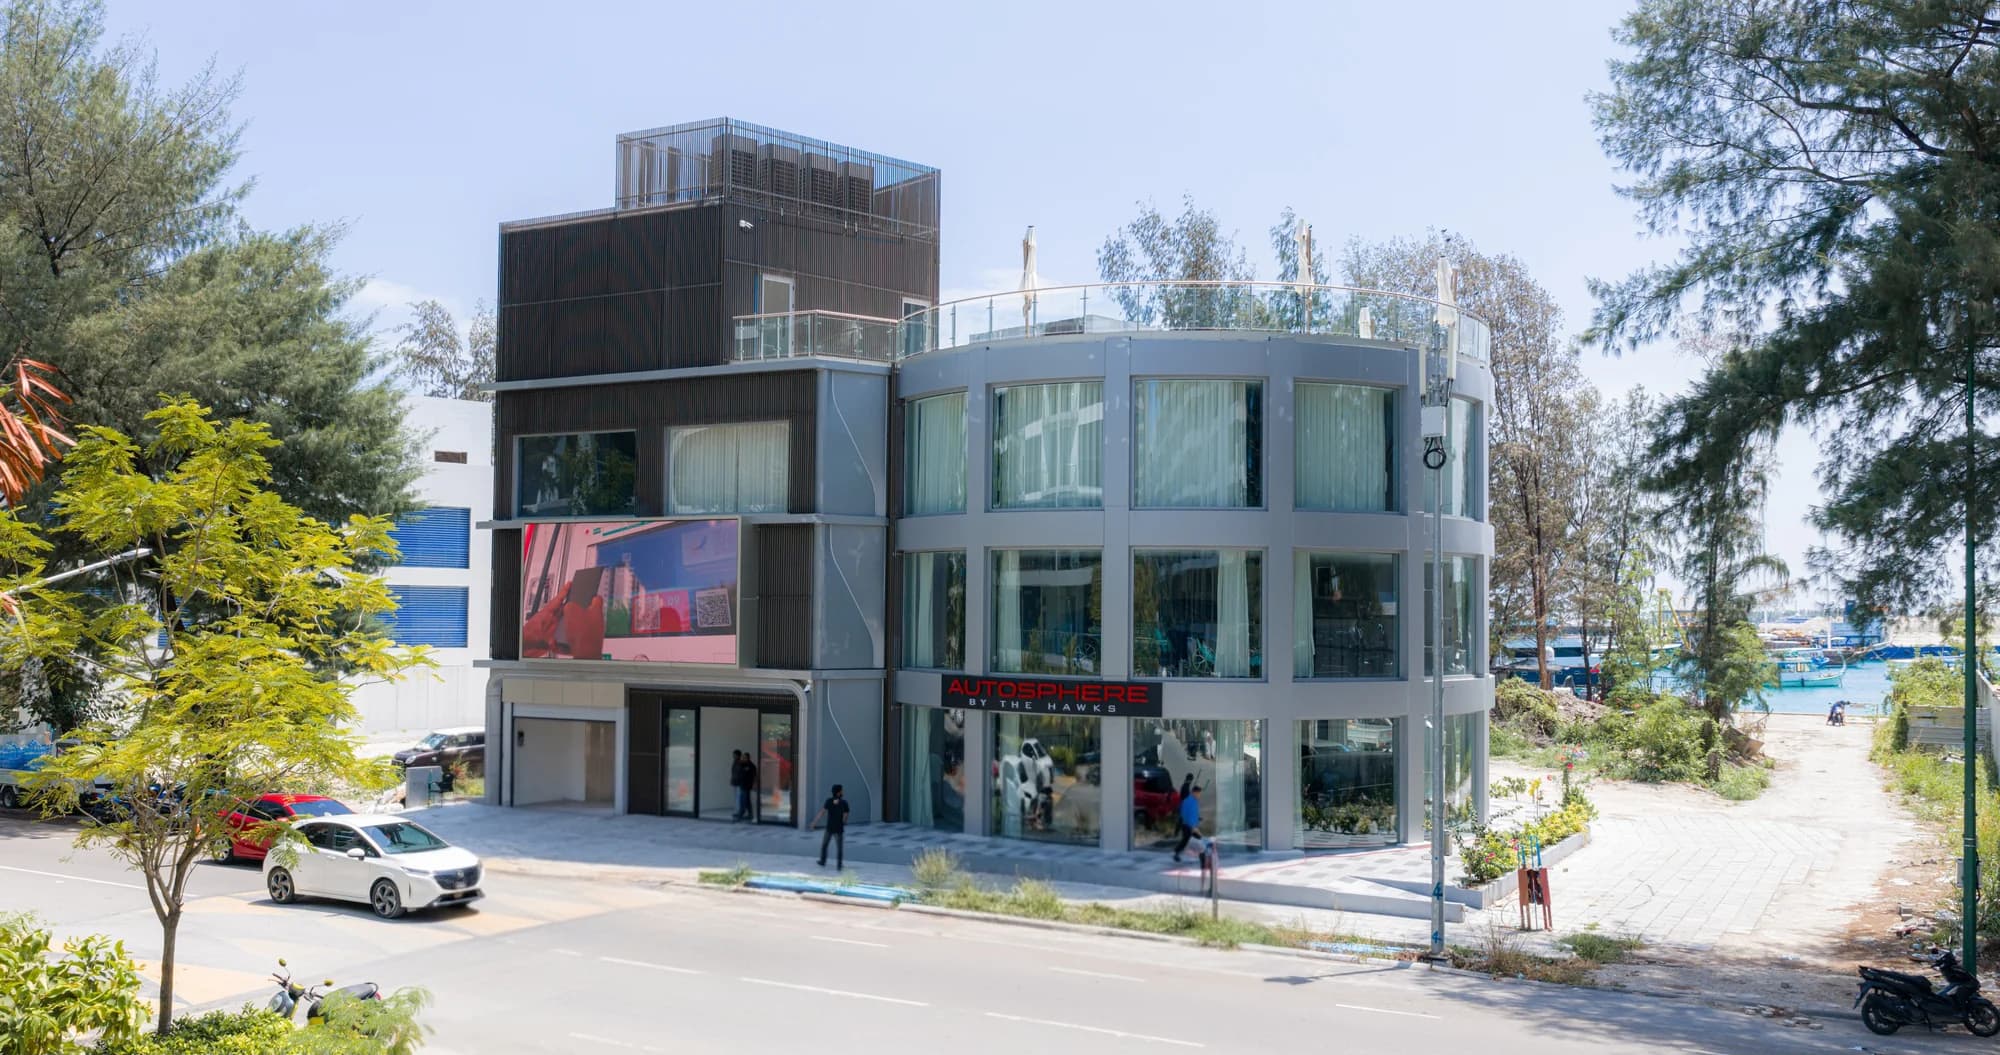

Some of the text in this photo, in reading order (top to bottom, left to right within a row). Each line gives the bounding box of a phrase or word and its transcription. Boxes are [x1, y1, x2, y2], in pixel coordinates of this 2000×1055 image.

[947, 679, 1149, 703] AUTOSPHERE
[969, 698, 1117, 713] BY THE HAWKS
[1432, 881, 1443, 900] 4
